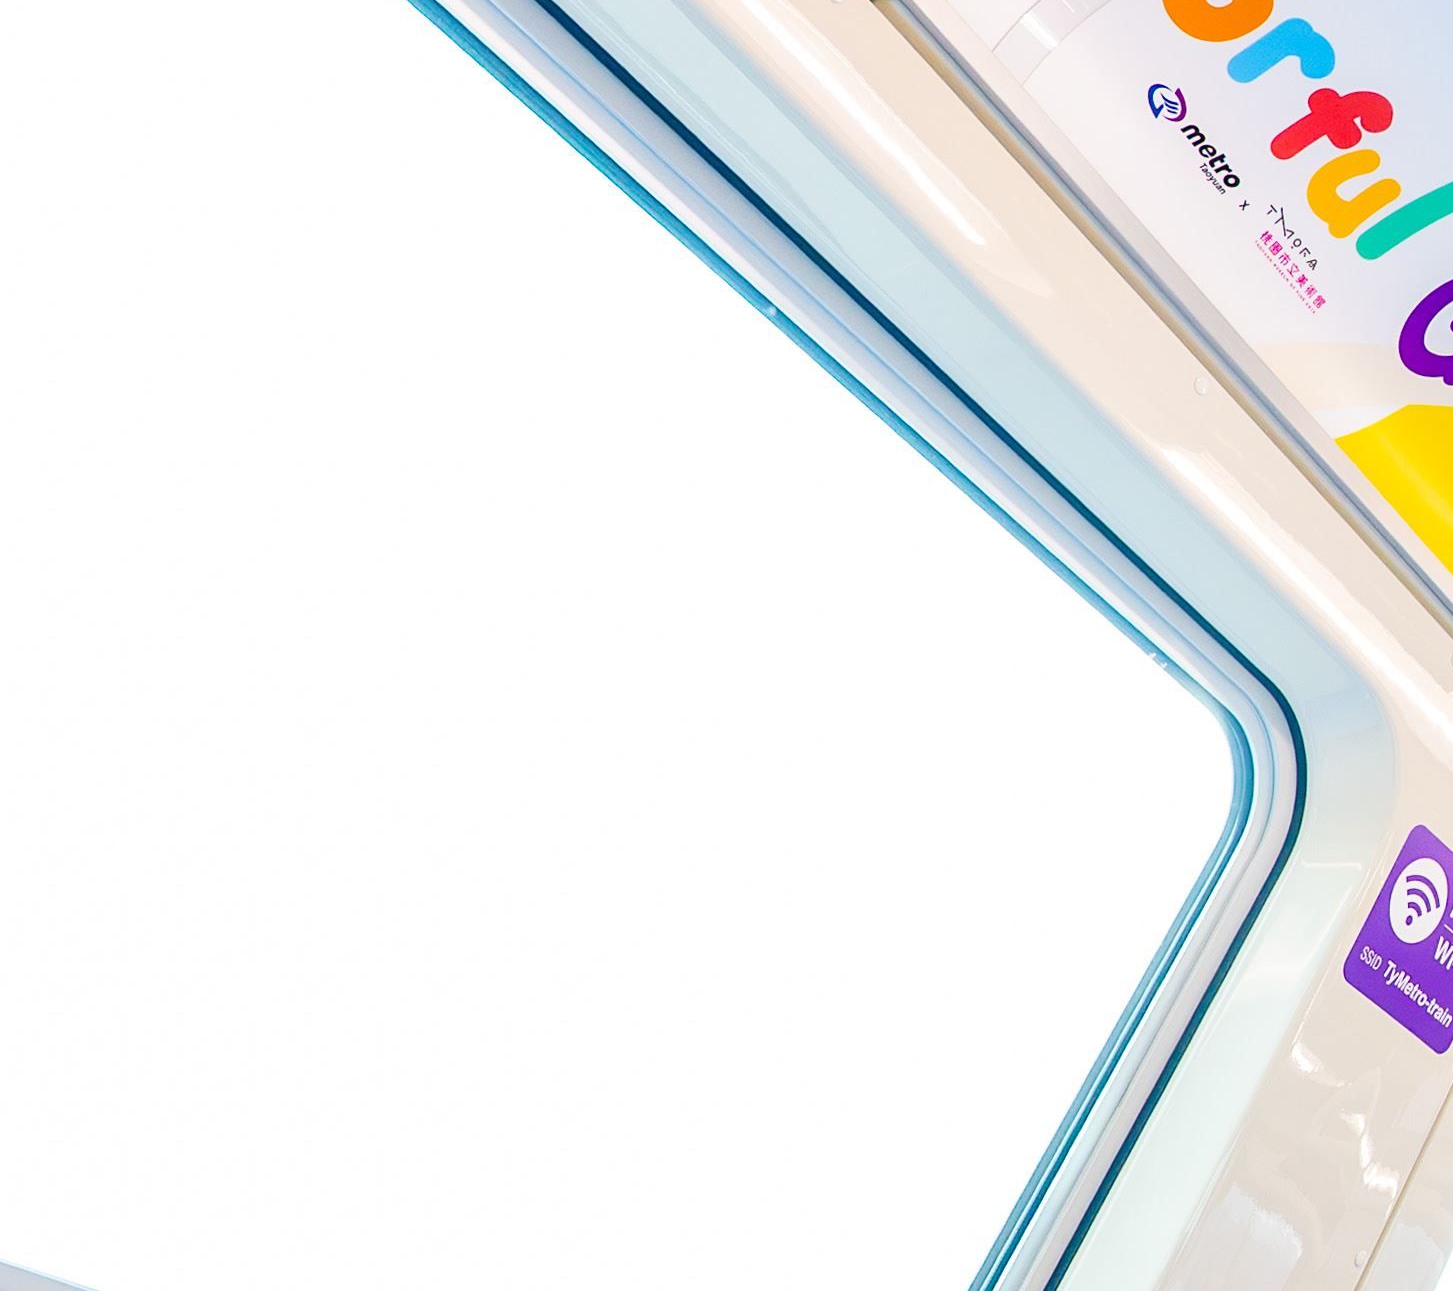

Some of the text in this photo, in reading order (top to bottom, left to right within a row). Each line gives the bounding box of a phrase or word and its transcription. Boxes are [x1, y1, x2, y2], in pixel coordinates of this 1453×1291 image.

[1180, 124, 1241, 188] metro
[1199, 162, 1226, 195] Taoyuan
[1259, 230, 1327, 309] 桃園市立美術館
[1359, 946, 1453, 1028] SSID TyMetro-train
